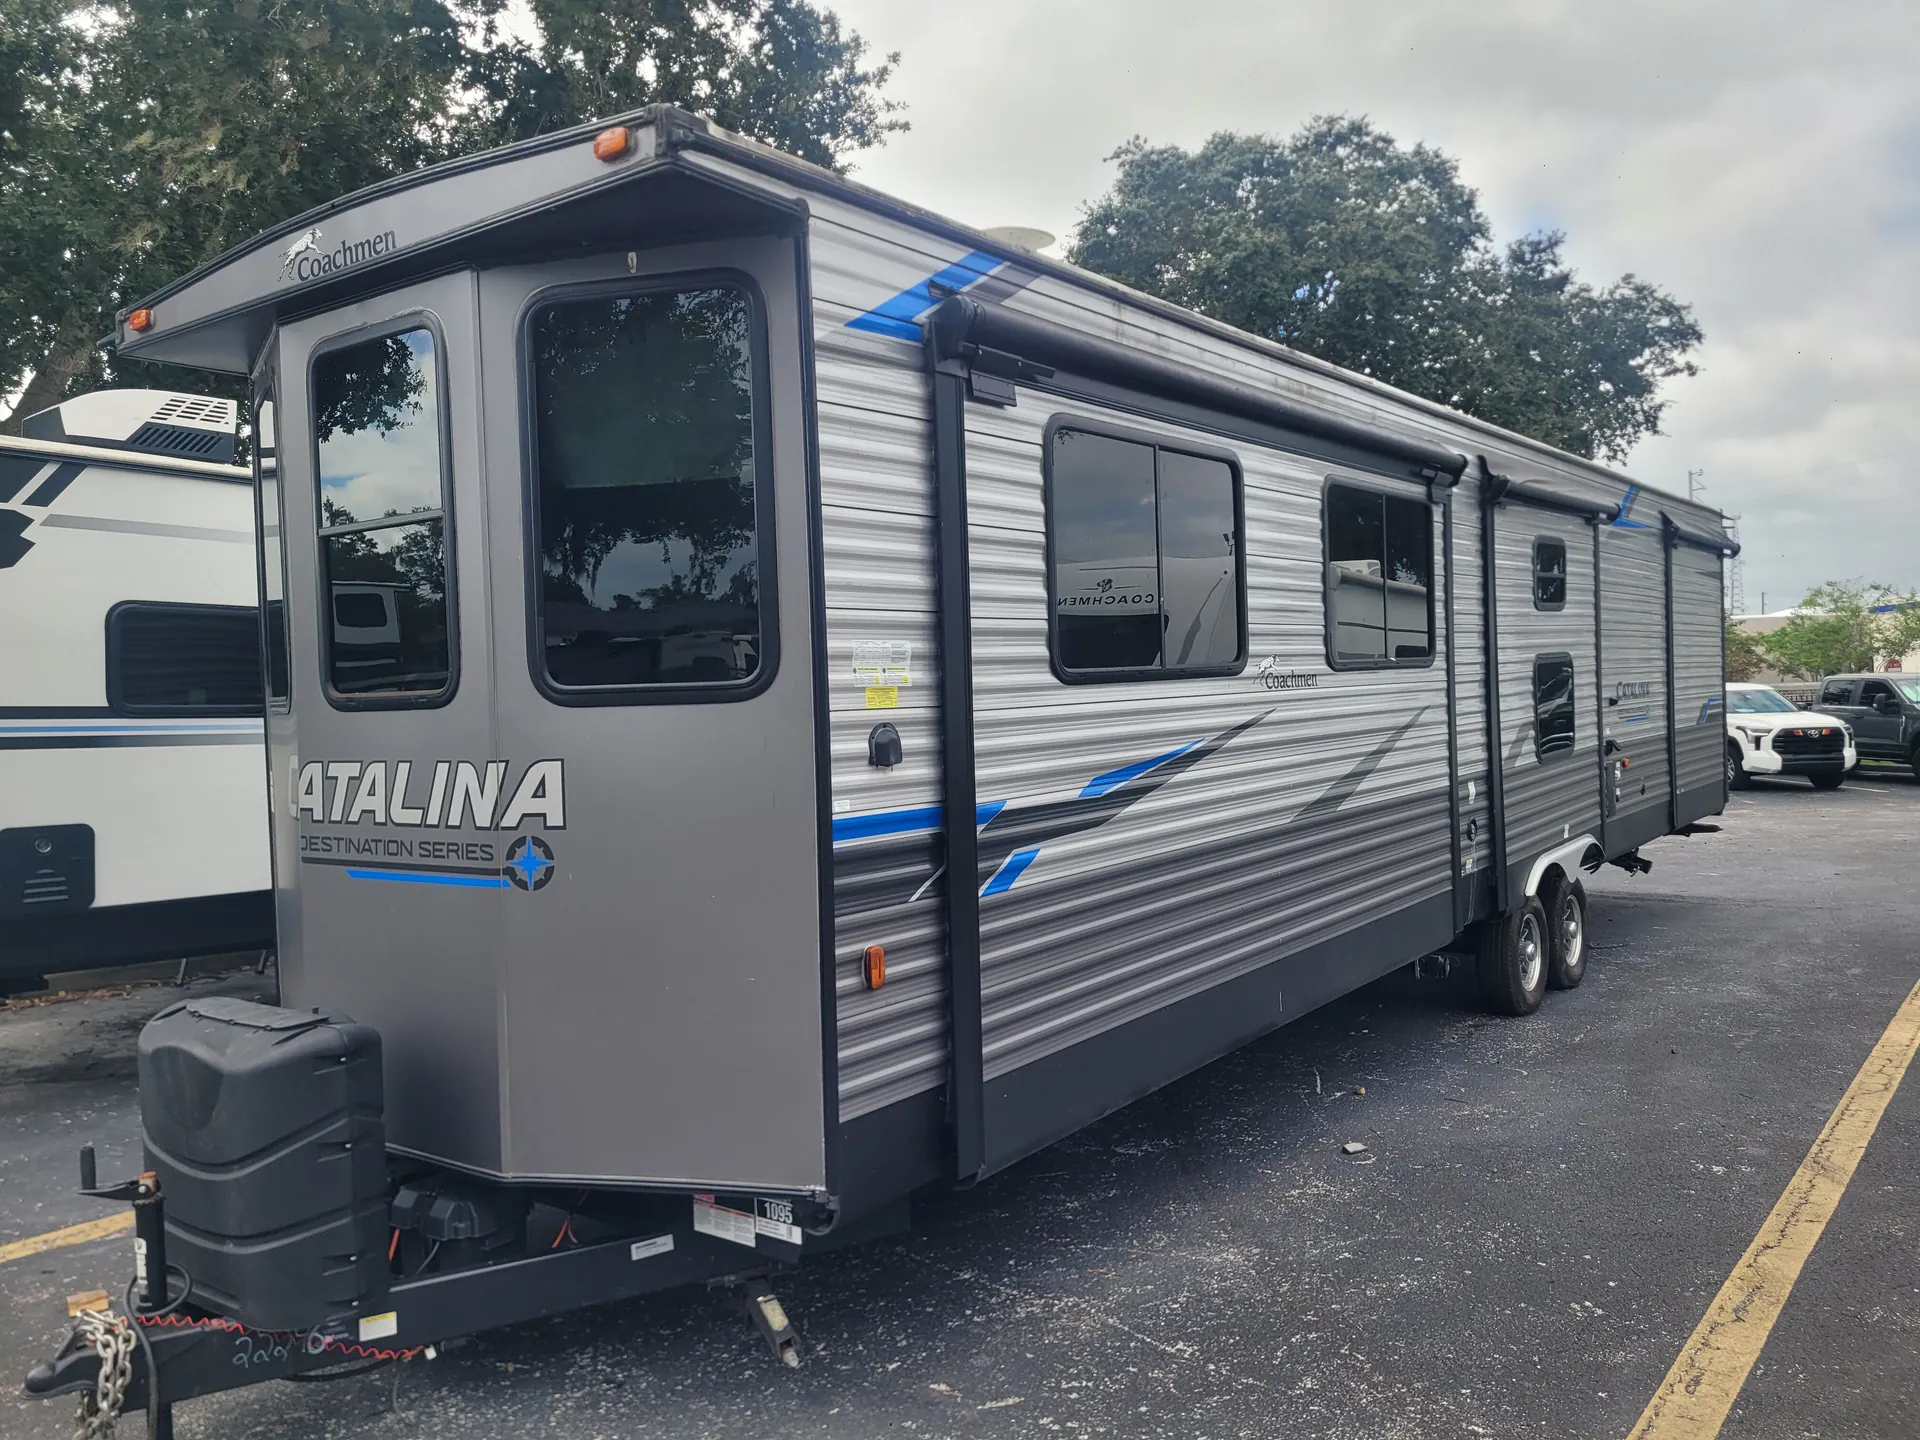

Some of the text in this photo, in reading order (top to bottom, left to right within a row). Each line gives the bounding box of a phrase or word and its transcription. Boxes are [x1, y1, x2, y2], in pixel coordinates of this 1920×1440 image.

[297, 229, 397, 282] Coachmen
[1265, 670, 1318, 690] Coachmen
[418, 840, 494, 861] SERIES
[764, 1201, 793, 1224] 1095
